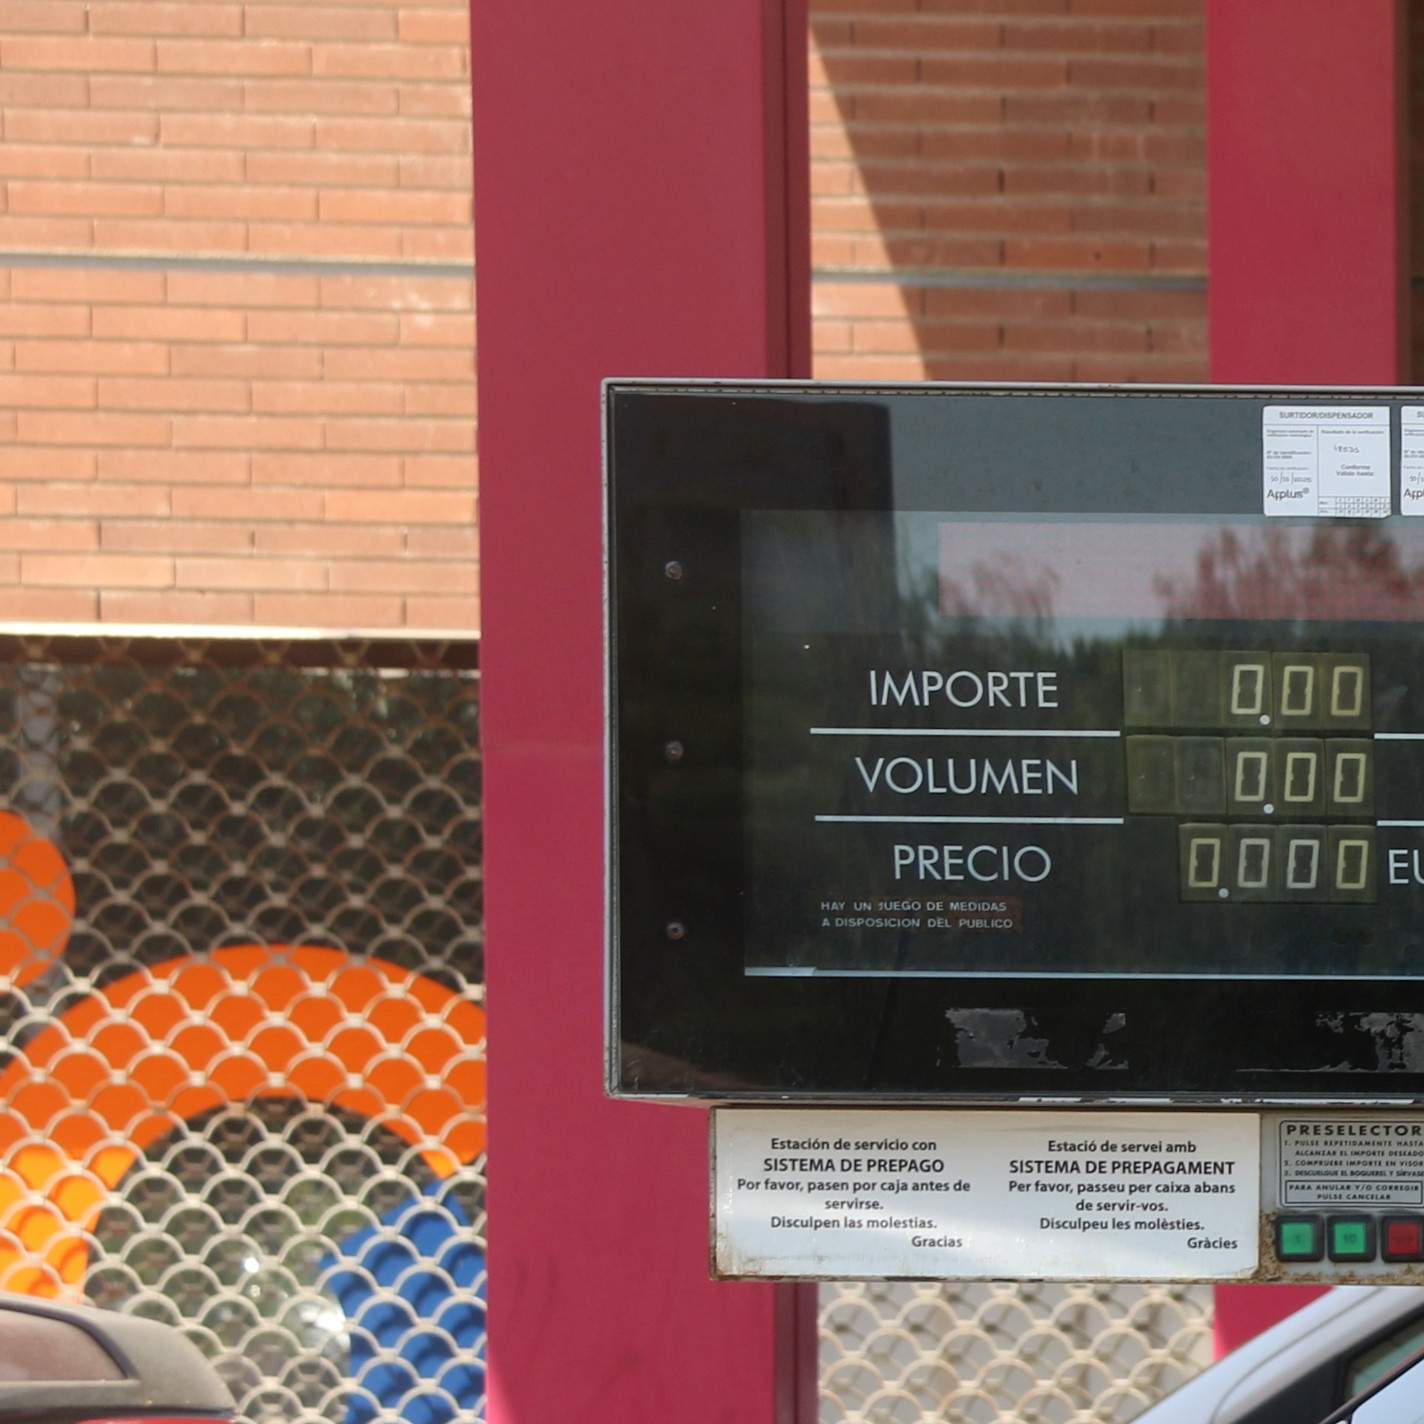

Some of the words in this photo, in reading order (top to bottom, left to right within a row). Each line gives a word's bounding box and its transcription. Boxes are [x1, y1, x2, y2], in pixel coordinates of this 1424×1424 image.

[869, 670, 1059, 708] IMPORTE
[854, 756, 1078, 795] VOLUMEN
[893, 844, 1052, 883] PRECIO
[820, 902, 846, 911] HAY
[853, 902, 872, 911] UN
[878, 902, 921, 911] JUEGO
[926, 902, 944, 911] DE
[950, 902, 1007, 911] MEDIDAS
[821, 918, 831, 928] A
[835, 918, 920, 928] DISPOSICION
[927, 918, 952, 928] DEL
[959, 918, 1013, 928] PUBLICO
[1286, 1125, 1422, 1136] PRESELECTOR
[771, 1137, 830, 1151] Estación
[833, 1138, 851, 1151] de
[854, 1138, 909, 1151] servicio
[911, 1141, 937, 1151] con
[1048, 1140, 1097, 1152] Estació
[1100, 1140, 1118, 1152] de
[1121, 1140, 1163, 1152] servei
[1165, 1140, 1197, 1153] amb
[763, 1158, 835, 1172] SISTEMA
[840, 1158, 862, 1173] DE
[866, 1158, 945, 1173] PREPAGO
[1009, 1160, 1081, 1174] SISTEMA
[1085, 1160, 1107, 1175] DE
[1111, 1160, 1235, 1175] PREPAGAMENT
[737, 1179, 761, 1191] Por
[764, 1178, 804, 1193] favor,
[807, 1181, 849, 1195] pasen
[852, 1181, 877, 1195] por
[879, 1179, 909, 1194] caja
[911, 1180, 950, 1192] antes
[953, 1178, 971, 1192] de
[1008, 1181, 1031, 1193] Per
[1034, 1180, 1074, 1194] favor,
[1077, 1183, 1125, 1196] passeu
[1128, 1183, 1152, 1196] per
[1155, 1181, 1190, 1193] caixa
[1194, 1181, 1236, 1194] abans
[824, 1198, 884, 1210] servirse.
[1075, 1199, 1094, 1212] de
[1096, 1199, 1169, 1212] servir-vos.
[770, 1216, 840, 1232] Disculpen
[843, 1216, 863, 1228] las
[866, 1216, 938, 1229] molestias.
[1040, 1217, 1109, 1233] Disculpeu
[1112, 1218, 1131, 1230] les
[1134, 1217, 1205, 1231] molèsties.
[911, 1235, 963, 1248] Gracias
[1187, 1237, 1239, 1249] Gràcies
